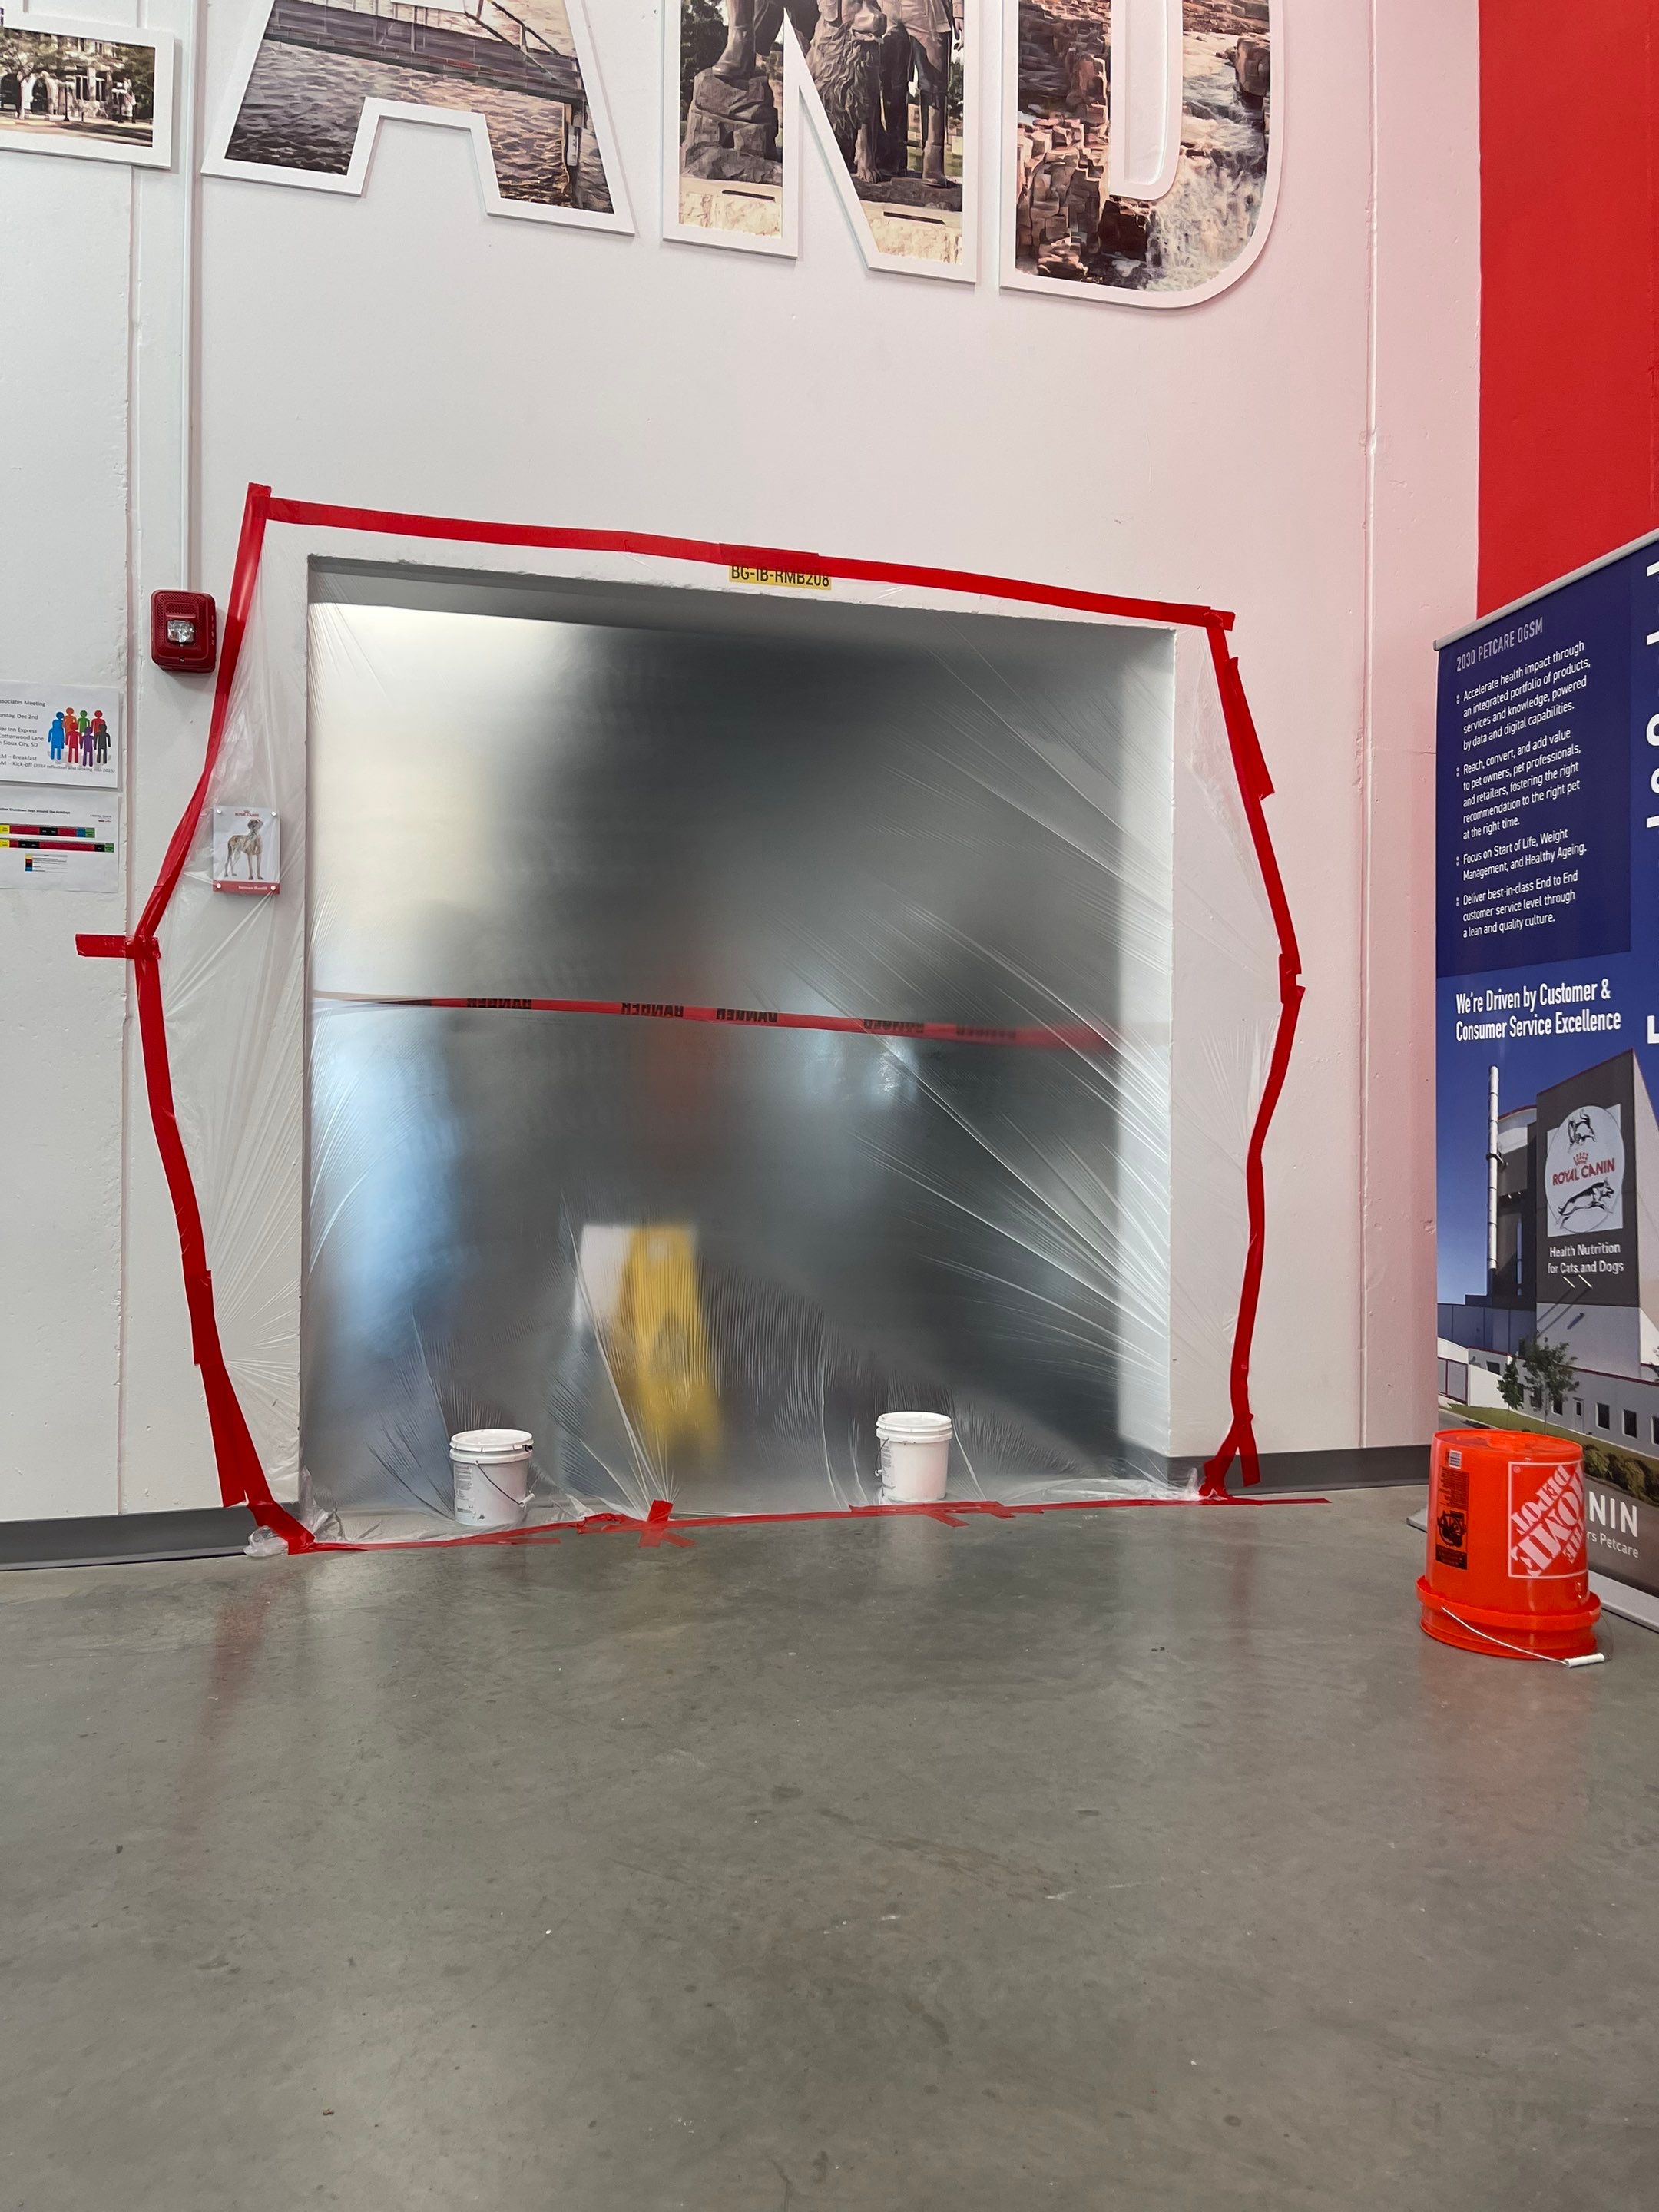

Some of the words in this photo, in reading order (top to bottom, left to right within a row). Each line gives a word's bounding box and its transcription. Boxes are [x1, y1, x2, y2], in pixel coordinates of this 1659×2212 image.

[1456, 649, 1475, 672] 2030
[1478, 630, 1515, 662] PETCARE
[1518, 617, 1543, 643] OGSM
[1463, 678, 1498, 702] Accelerate
[1500, 667, 1524, 686] health
[1525, 656, 1551, 675] impact
[1552, 641, 1584, 663] through
[1463, 707, 1472, 718] an
[1472, 690, 1508, 714] integrated
[1510, 677, 1541, 701] portfolio
[1543, 671, 1551, 685] of
[1552, 658, 1591, 684] products,
[1463, 716, 1491, 734] services
[1492, 707, 1506, 723] and
[1508, 692, 1550, 717] knowledge,
[1551, 675, 1587, 702] powered
[1463, 740, 1471, 751] by
[1472, 734, 1488, 747] data
[1488, 726, 1502, 740] and
[1504, 717, 1527, 735] digital
[1528, 701, 1575, 726] capabilities.
[1463, 759, 1485, 775] Reach,
[1485, 748, 1516, 767] convert,
[1517, 740, 1531, 756] and
[1532, 735, 1548, 750] add
[1548, 729, 1571, 745] value
[1463, 781, 1470, 791] to
[1471, 780, 1482, 791] pet
[1482, 768, 1512, 784] owners,
[1513, 761, 1525, 777] pet
[1526, 743, 1581, 773] professionals,
[1463, 793, 1475, 808] and
[1476, 786, 1508, 803] retailers,
[1509, 775, 1543, 793] fostering
[1545, 770, 1558, 782] the
[1559, 762, 1579, 778] right
[1463, 799, 1521, 824] recommendation
[1522, 796, 1530, 806] to
[1531, 791, 1544, 803] the
[1545, 783, 1565, 800] right
[1567, 780, 1580, 796] pet
[1463, 830, 1470, 840] at
[1471, 826, 1482, 838] the
[1482, 820, 1501, 836] right
[1502, 816, 1521, 830] time.
[1463, 853, 1482, 865] Focus
[1482, 849, 1492, 859] on
[1493, 843, 1512, 856] Start
[1514, 839, 1522, 852] of
[1522, 835, 1538, 849] Life,
[1540, 828, 1568, 845] Weight
[1463, 861, 1509, 881] Management,
[1510, 856, 1524, 869] and
[1525, 849, 1556, 866] Healthy
[1556, 843, 1588, 860] Ageing.
[1462, 907, 1495, 922] customer
[1495, 901, 1522, 916] service
[1523, 895, 1543, 910] level
[1544, 889, 1575, 906] through
[1463, 892, 1486, 906] Deliver
[1487, 881, 1534, 900] best-in-class
[1535, 876, 1551, 890] End
[1553, 874, 1561, 886] to
[1562, 869, 1578, 884] End
[1462, 929, 1468, 938] a
[1468, 926, 1482, 937] lean
[1483, 922, 1498, 935] and
[1498, 917, 1524, 934] quality
[1525, 912, 1556, 927] culture.
[1455, 992, 1483, 1015] We're
[1486, 988, 1520, 1012] Driven
[1523, 985, 1537, 1013] by
[1539, 981, 1598, 1005] Customer
[1601, 978, 1611, 999] &
[1455, 1020, 1507, 1042] Consumer
[1509, 1014, 1551, 1038] Service
[1555, 1008, 1621, 1034] Excellence
[1552, 1171, 1578, 1187] ROYAL
[1581, 1158, 1615, 1179] CANIN
[1548, 1263, 1558, 1275] for
[1580, 1260, 1597, 1273] and
[1599, 1260, 1624, 1275] Dogs
[1549, 1245, 1575, 1258] Health
[1577, 1241, 1621, 1256] Nutrition
[1511, 1465, 1571, 1535] DEPOT
[1589, 1491, 1638, 1538] NIN
[1586, 1531, 1597, 1542] rs
[1600, 1532, 1638, 1558] Petcare
